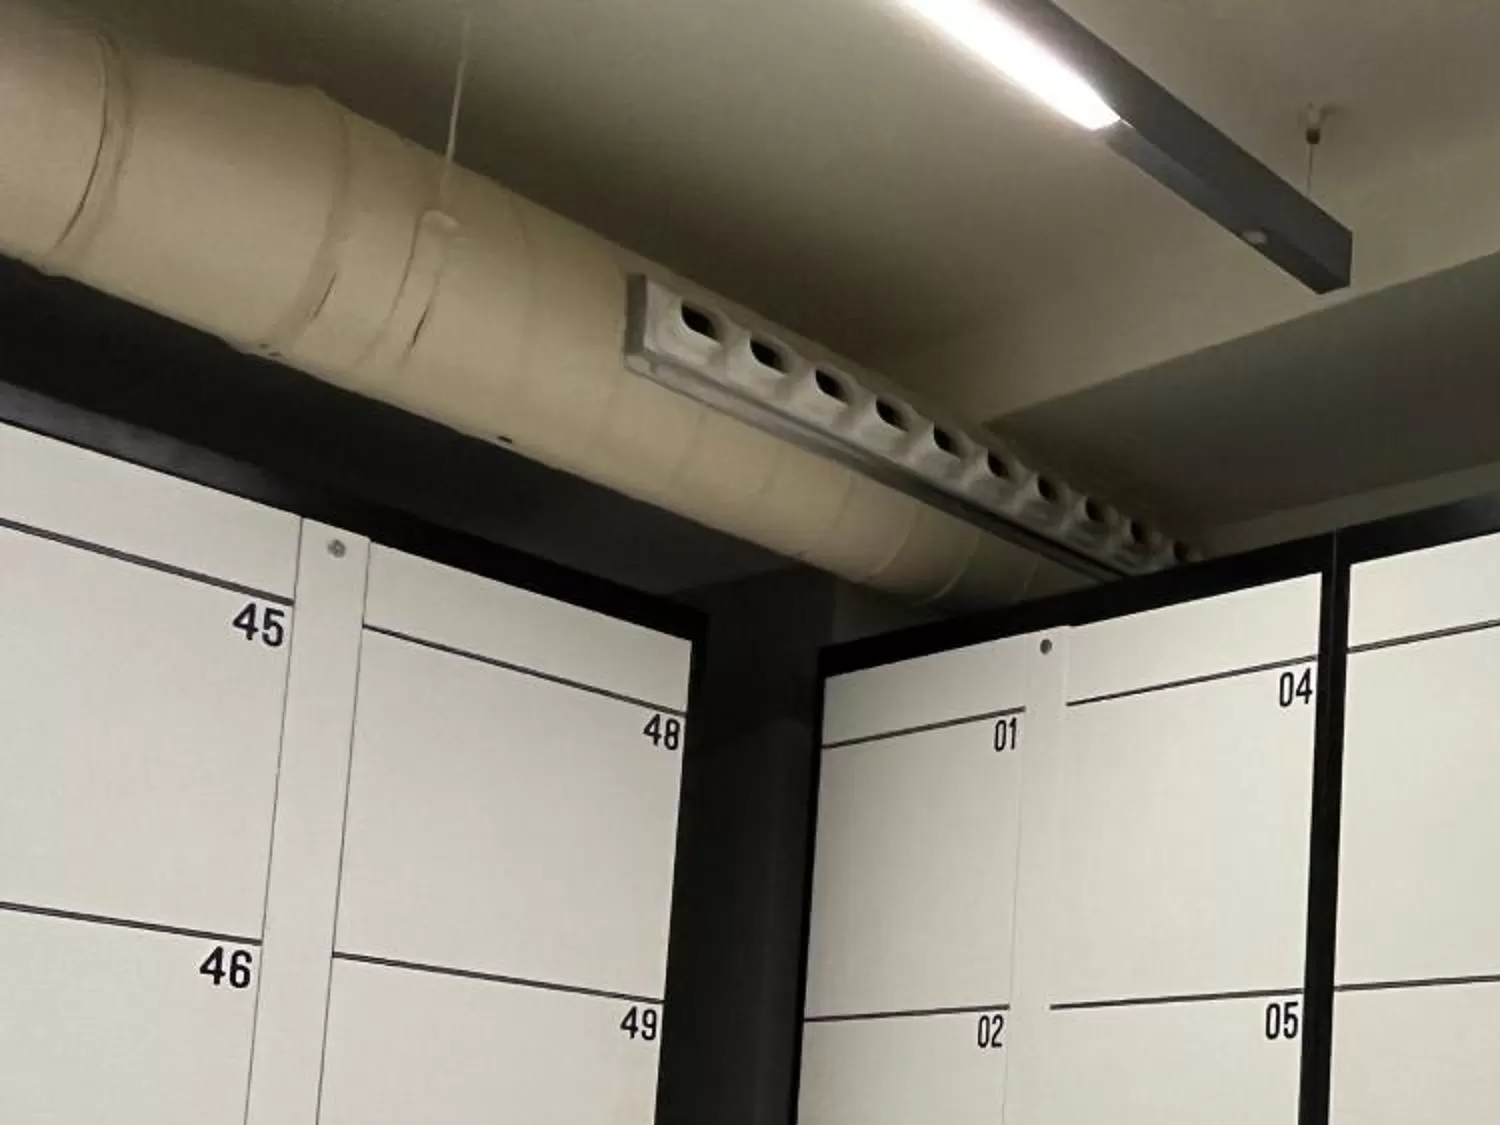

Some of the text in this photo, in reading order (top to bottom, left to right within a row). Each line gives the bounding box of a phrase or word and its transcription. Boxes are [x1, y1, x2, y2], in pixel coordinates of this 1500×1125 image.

[233, 603, 284, 647] 45
[1279, 668, 1312, 707] 04
[643, 714, 680, 750] 48
[993, 717, 1017, 752] 01
[200, 946, 252, 988] 46
[620, 1006, 658, 1041] 49
[978, 1014, 1005, 1049] 02
[1265, 1002, 1299, 1040] 05
